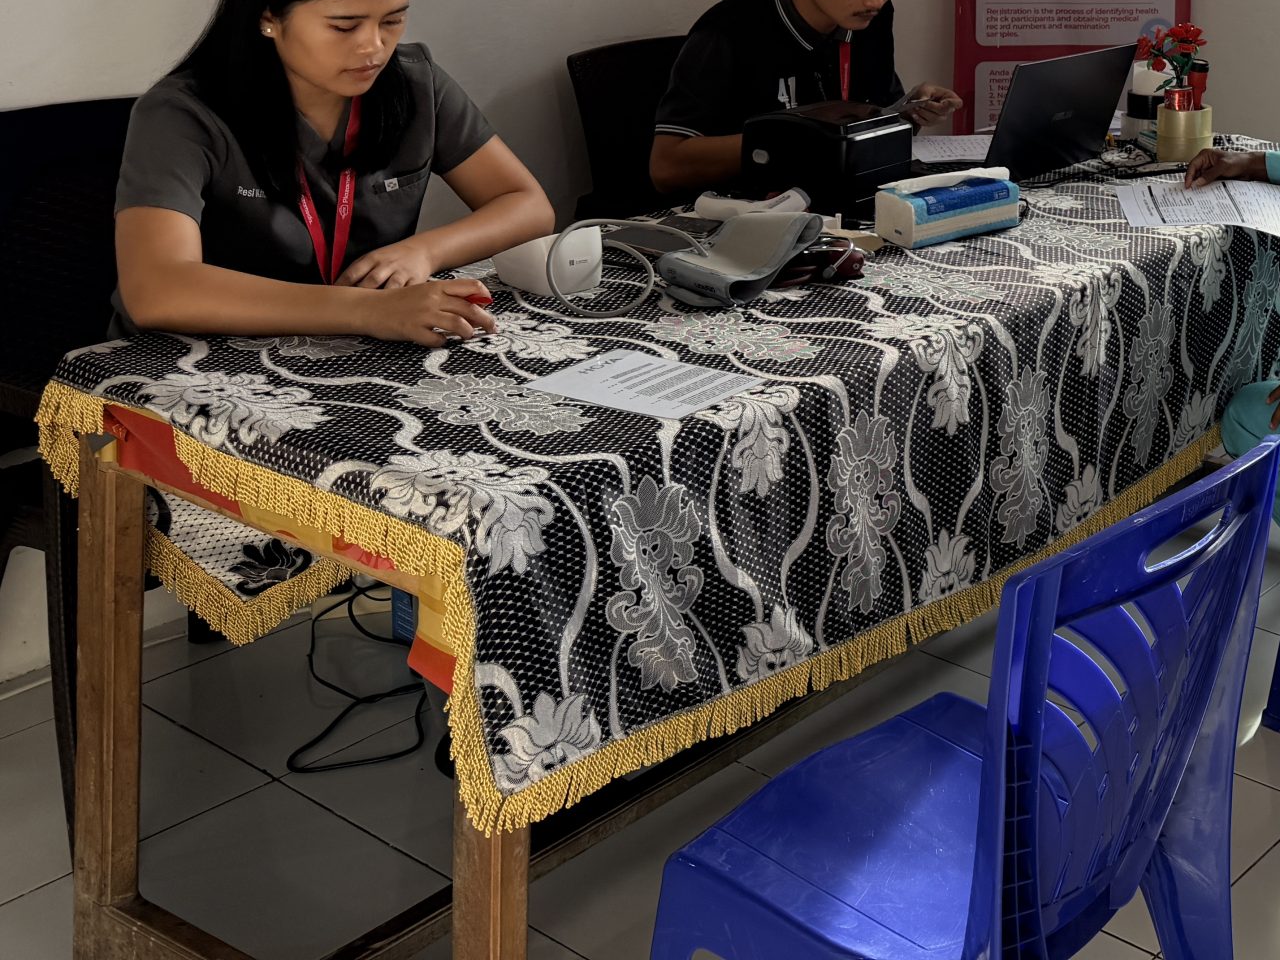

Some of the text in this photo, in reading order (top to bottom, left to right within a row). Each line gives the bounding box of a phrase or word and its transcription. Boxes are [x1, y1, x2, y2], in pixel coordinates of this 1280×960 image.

[1055, 9, 1085, 17] process
[1094, 8, 1134, 17] identifying
[1011, 15, 1055, 24] participants
[1073, 16, 1109, 24] obtaining
